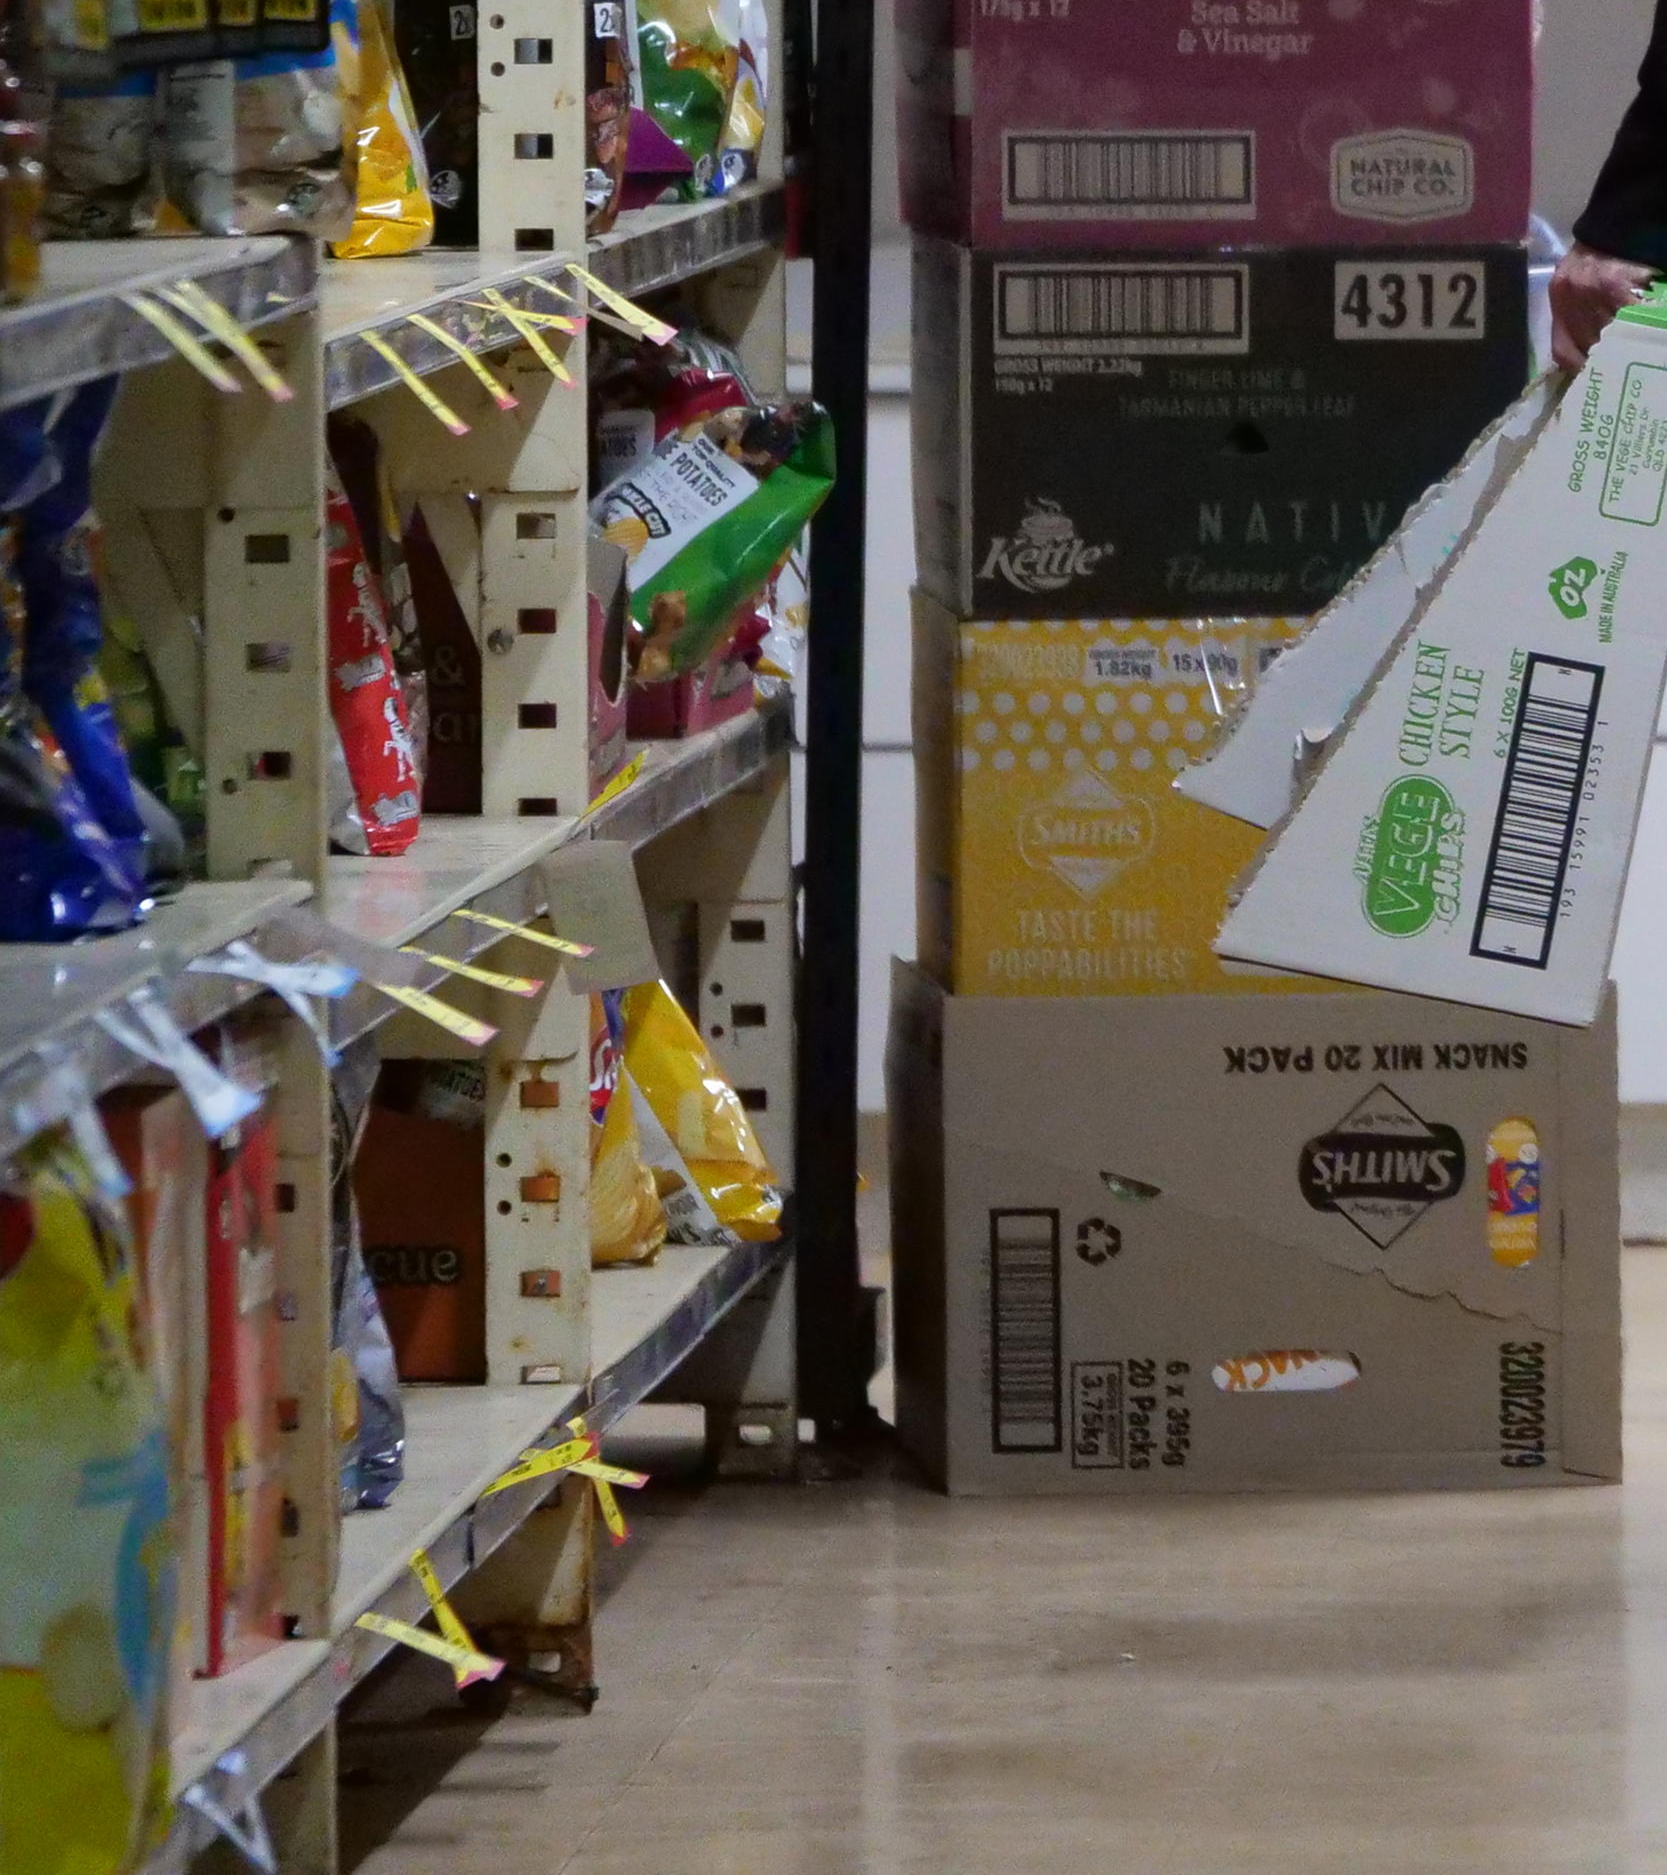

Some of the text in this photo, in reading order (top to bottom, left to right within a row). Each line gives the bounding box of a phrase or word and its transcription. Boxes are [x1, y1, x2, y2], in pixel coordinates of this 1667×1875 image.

[1201, 28, 1314, 62] Vinegar
[1350, 158, 1457, 177] NATURAL
[1350, 178, 1456, 198] CHIP CO.
[1340, 272, 1478, 328] 4312
[1629, 379, 1643, 399] CO
[1567, 366, 1603, 494] GROSS WEIGHT
[1614, 439, 1633, 472] VEGE
[669, 451, 729, 507] POTATOES
[1608, 476, 1625, 503] THE
[975, 536, 1103, 594] Kettle
[1601, 550, 1629, 603] AUSTRALIA
[1559, 568, 1587, 607] OZ
[1598, 613, 1613, 644] MADE
[1507, 647, 1526, 682] NET
[1396, 638, 1452, 767] CHICKEN
[1437, 665, 1485, 760] STYLE
[1372, 791, 1440, 916] VEGE
[1431, 808, 1466, 926] CHIPS
[1558, 887, 1578, 919] 193
[1017, 908, 1159, 943] TASTE THE
[1222, 1041, 1529, 1074] SNACK MIX 20 PACK
[1311, 1149, 1457, 1194] SMITH'S
[1166, 1360, 1191, 1377] 6
[1077, 1374, 1104, 1457] 3.75kg
[1127, 1357, 1158, 1470] 20 Packs
[1500, 1340, 1546, 1470] 320023979
